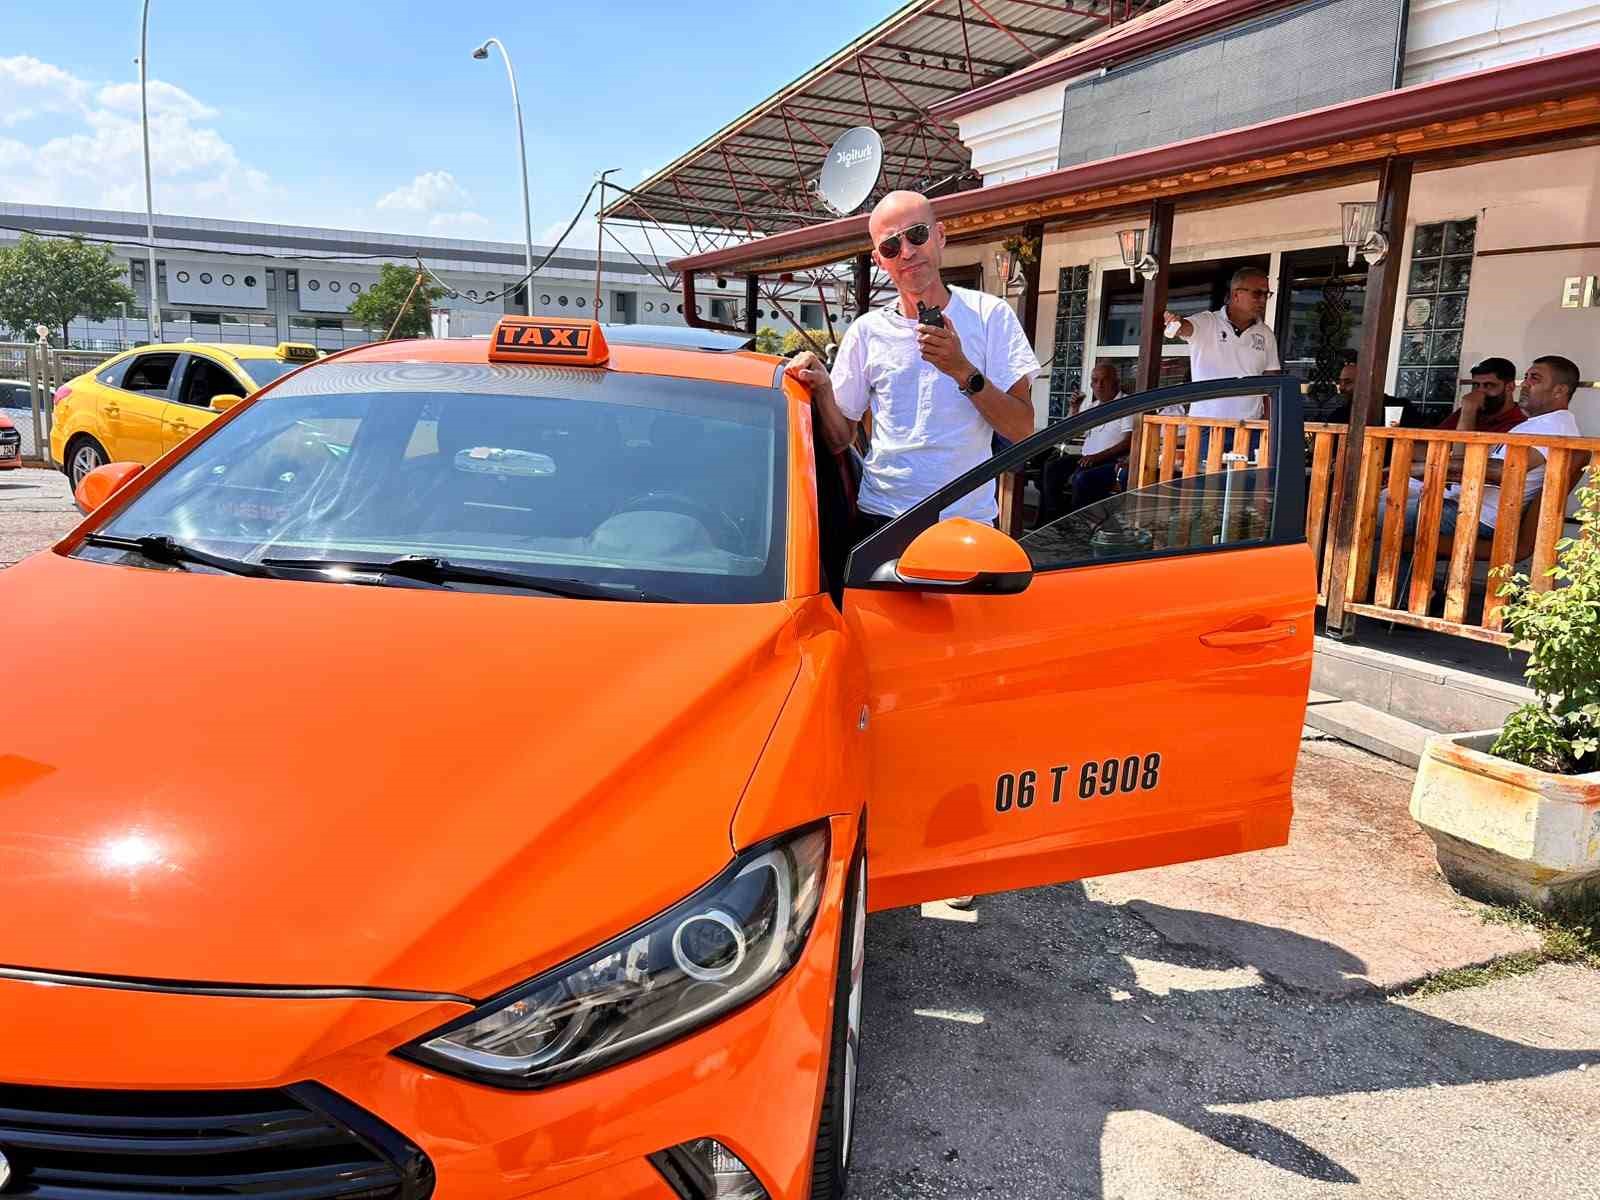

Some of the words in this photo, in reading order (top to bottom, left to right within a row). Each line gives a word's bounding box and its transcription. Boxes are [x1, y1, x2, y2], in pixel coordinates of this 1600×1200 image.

[501, 326, 588, 347] TAXI
[995, 770, 1036, 812] 06
[1051, 766, 1069, 803] T
[1078, 752, 1161, 799] 6908
